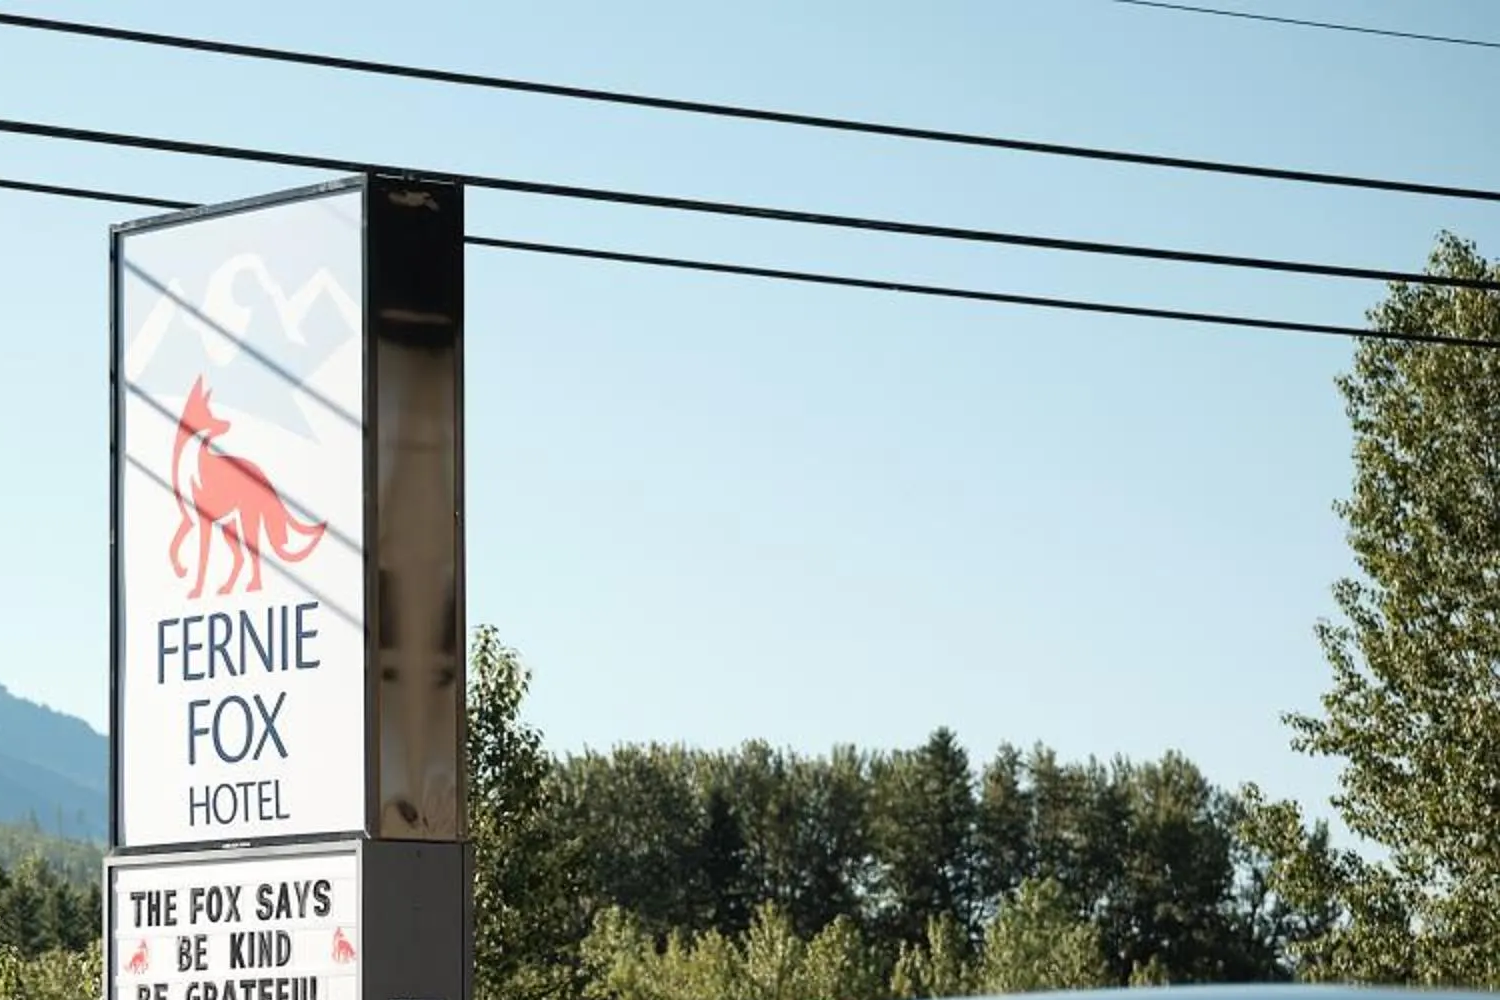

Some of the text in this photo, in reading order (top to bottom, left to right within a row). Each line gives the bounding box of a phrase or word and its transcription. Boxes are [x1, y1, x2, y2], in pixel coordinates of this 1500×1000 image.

[158, 601, 320, 684] FERNIE
[188, 692, 288, 765] FOX
[189, 780, 290, 826] HOTEL
[130, 880, 331, 927] THE FOX SAYS
[178, 930, 291, 972] BE KIND
